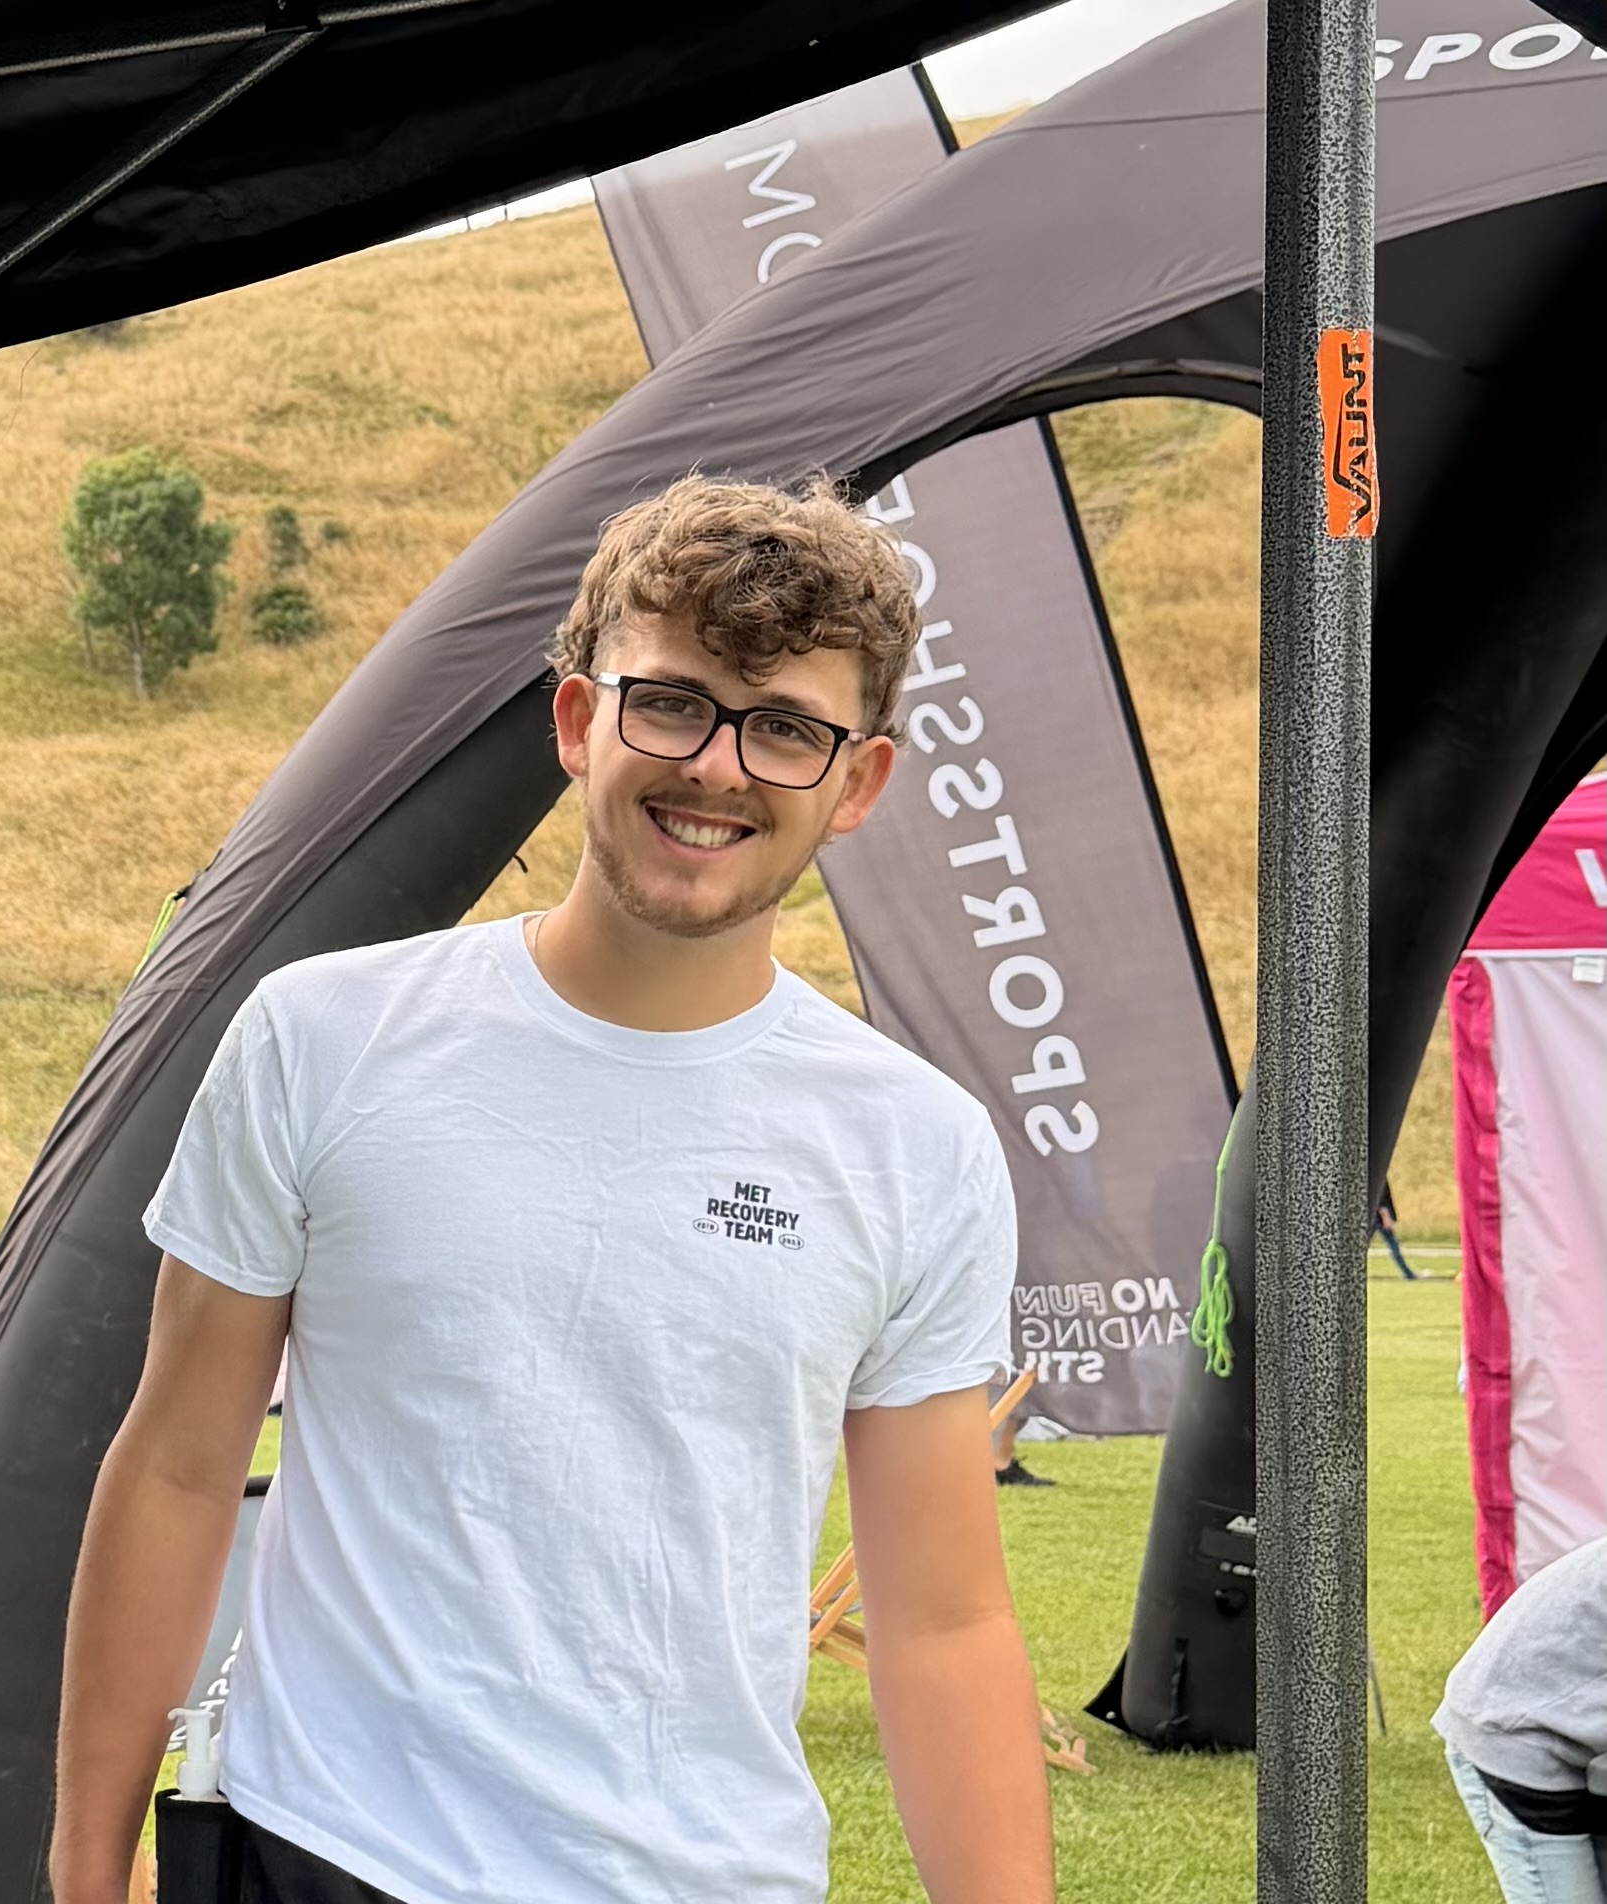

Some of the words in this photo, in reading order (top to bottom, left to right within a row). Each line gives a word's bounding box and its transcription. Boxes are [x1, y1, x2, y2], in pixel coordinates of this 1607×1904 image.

[1375, 23, 1607, 82] PO
[1333, 342, 1373, 529] VAUNT
[734, 1181, 771, 1204] MET
[706, 1197, 800, 1231] RECOVERY
[724, 1220, 773, 1245] TEAM
